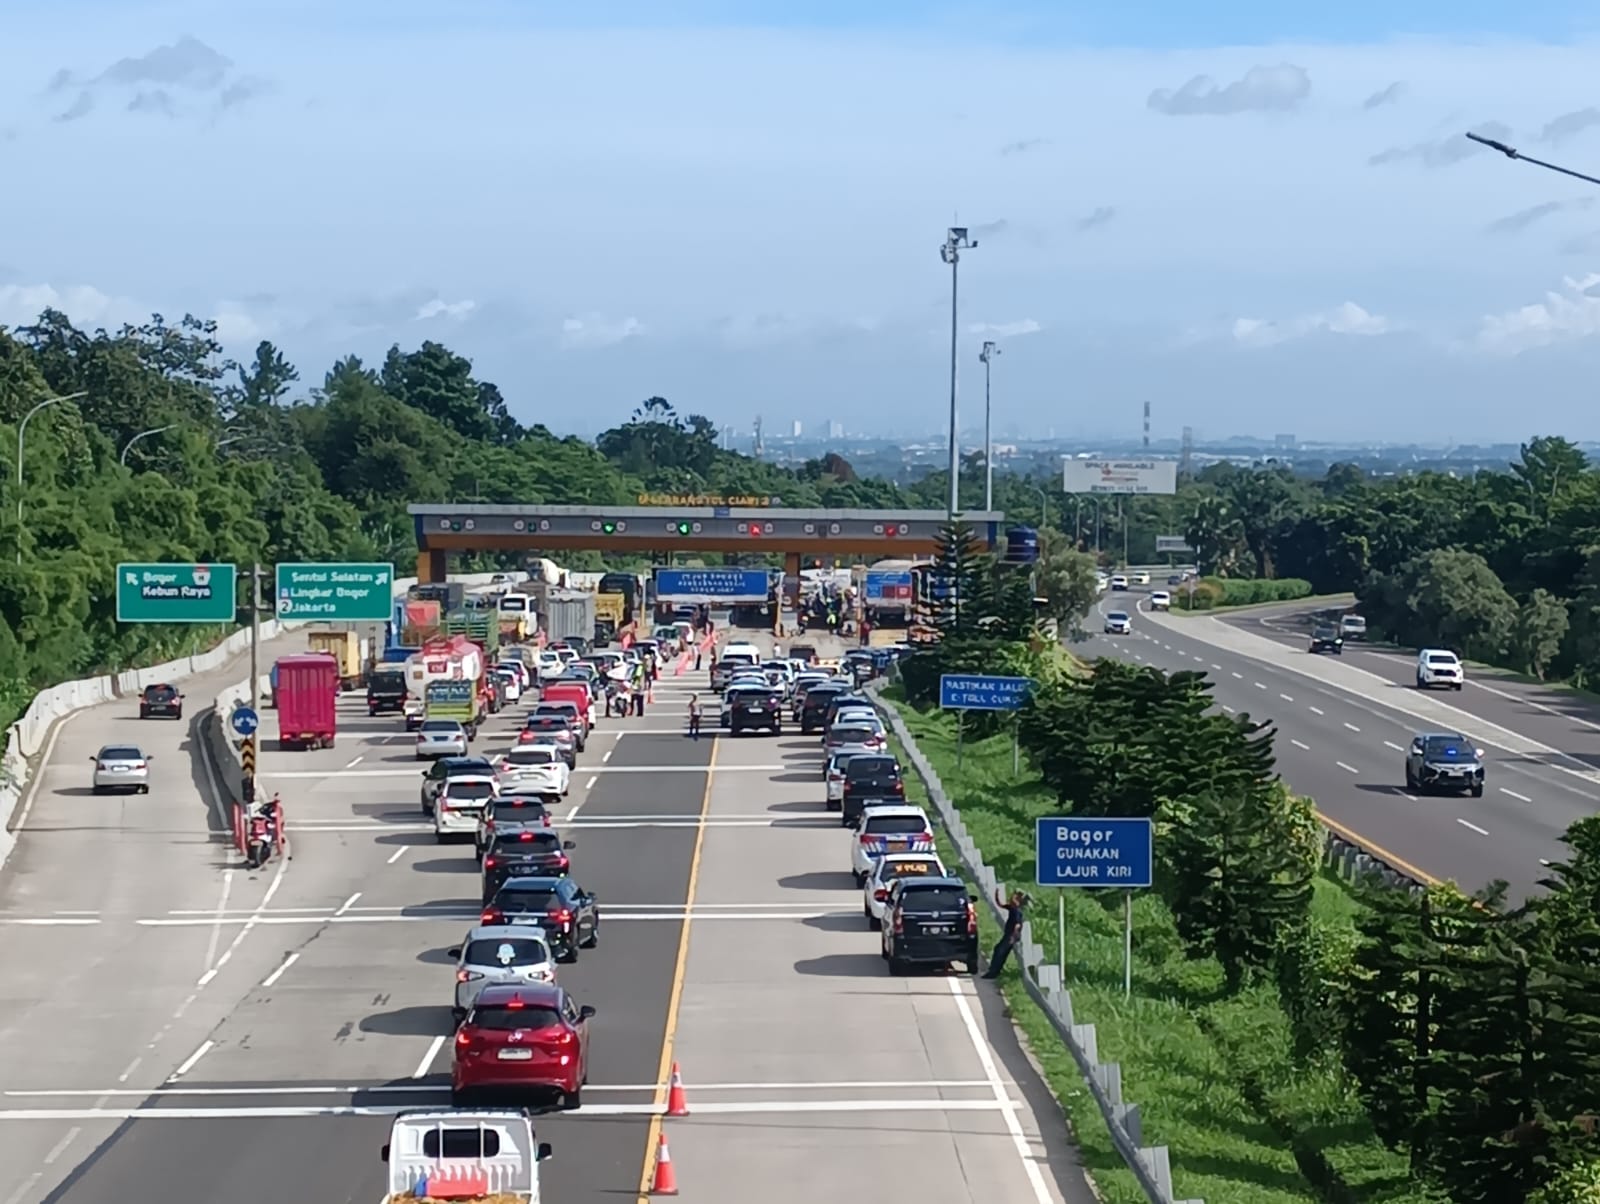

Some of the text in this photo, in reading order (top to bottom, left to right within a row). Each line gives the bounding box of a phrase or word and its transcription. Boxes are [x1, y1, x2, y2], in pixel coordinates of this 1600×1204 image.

[281, 601, 289, 611] 2
[292, 602, 336, 612] Jakarta
[1056, 826, 1113, 846] Bogor
[1056, 847, 1119, 859] GUNAKAN
[1056, 865, 1132, 877] LAJUR KIRI
